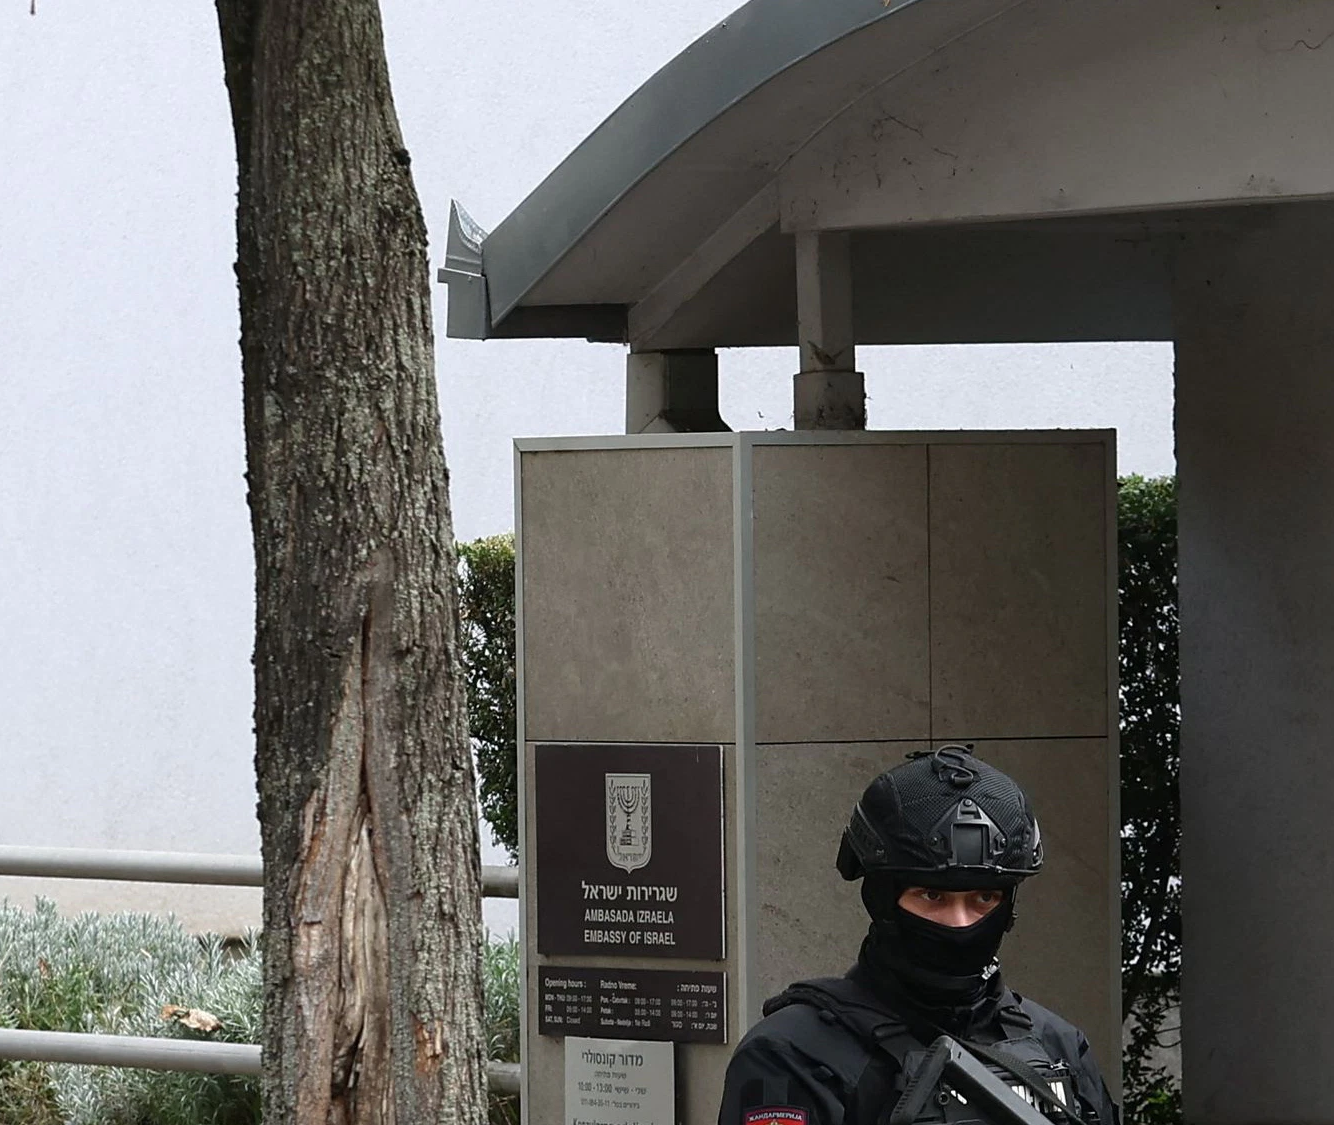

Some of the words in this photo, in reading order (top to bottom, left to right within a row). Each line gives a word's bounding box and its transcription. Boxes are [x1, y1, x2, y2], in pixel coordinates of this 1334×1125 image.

[581, 880, 622, 900] ישראל
[626, 885, 678, 902] שגרירות
[584, 909, 635, 923] AMBASADA
[637, 910, 674, 924] IZRAELA
[584, 929, 627, 943] EMBASSY
[629, 931, 641, 944] OF
[644, 932, 676, 945] ISRAEL
[545, 978, 567, 989] Opening
[600, 980, 618, 989] Radno
[582, 1049, 616, 1068] קונסולרי
[619, 1054, 643, 1067] מדור
[748, 1112, 803, 1122] ЖАНДАРМЕРИЈА
